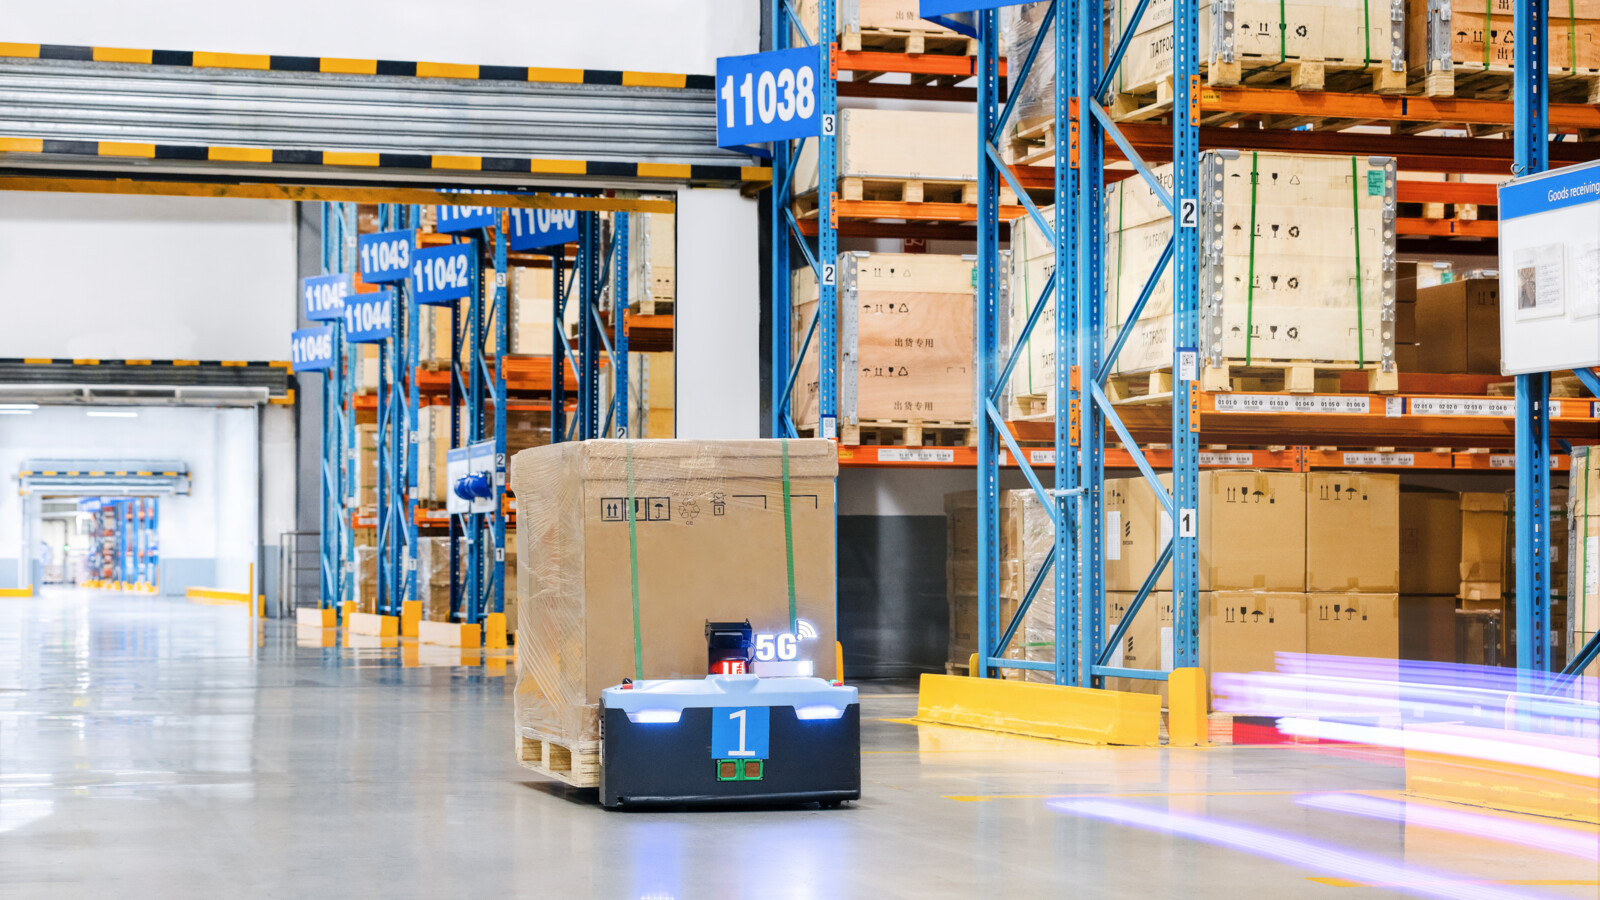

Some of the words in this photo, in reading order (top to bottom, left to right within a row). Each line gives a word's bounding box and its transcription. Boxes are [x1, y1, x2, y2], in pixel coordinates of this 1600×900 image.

[721, 65, 815, 128] 11038
[825, 116, 834, 133] 3
[1547, 186, 1569, 202] Goods
[1570, 181, 1600, 197] receiving
[511, 192, 576, 237] 11040
[1182, 202, 1195, 224] 2
[362, 239, 410, 273] 11043
[413, 254, 468, 293] 11042
[499, 274, 504, 285] 3
[825, 266, 834, 282] 2
[345, 301, 390, 333] 11044
[292, 334, 332, 363] 11046
[895, 337, 934, 348] 出货专用
[894, 401, 933, 412] 出货专用
[497, 454, 504, 466] 2
[1182, 513, 1190, 532] 1
[755, 633, 797, 661] 5G
[728, 709, 756, 757] 1
